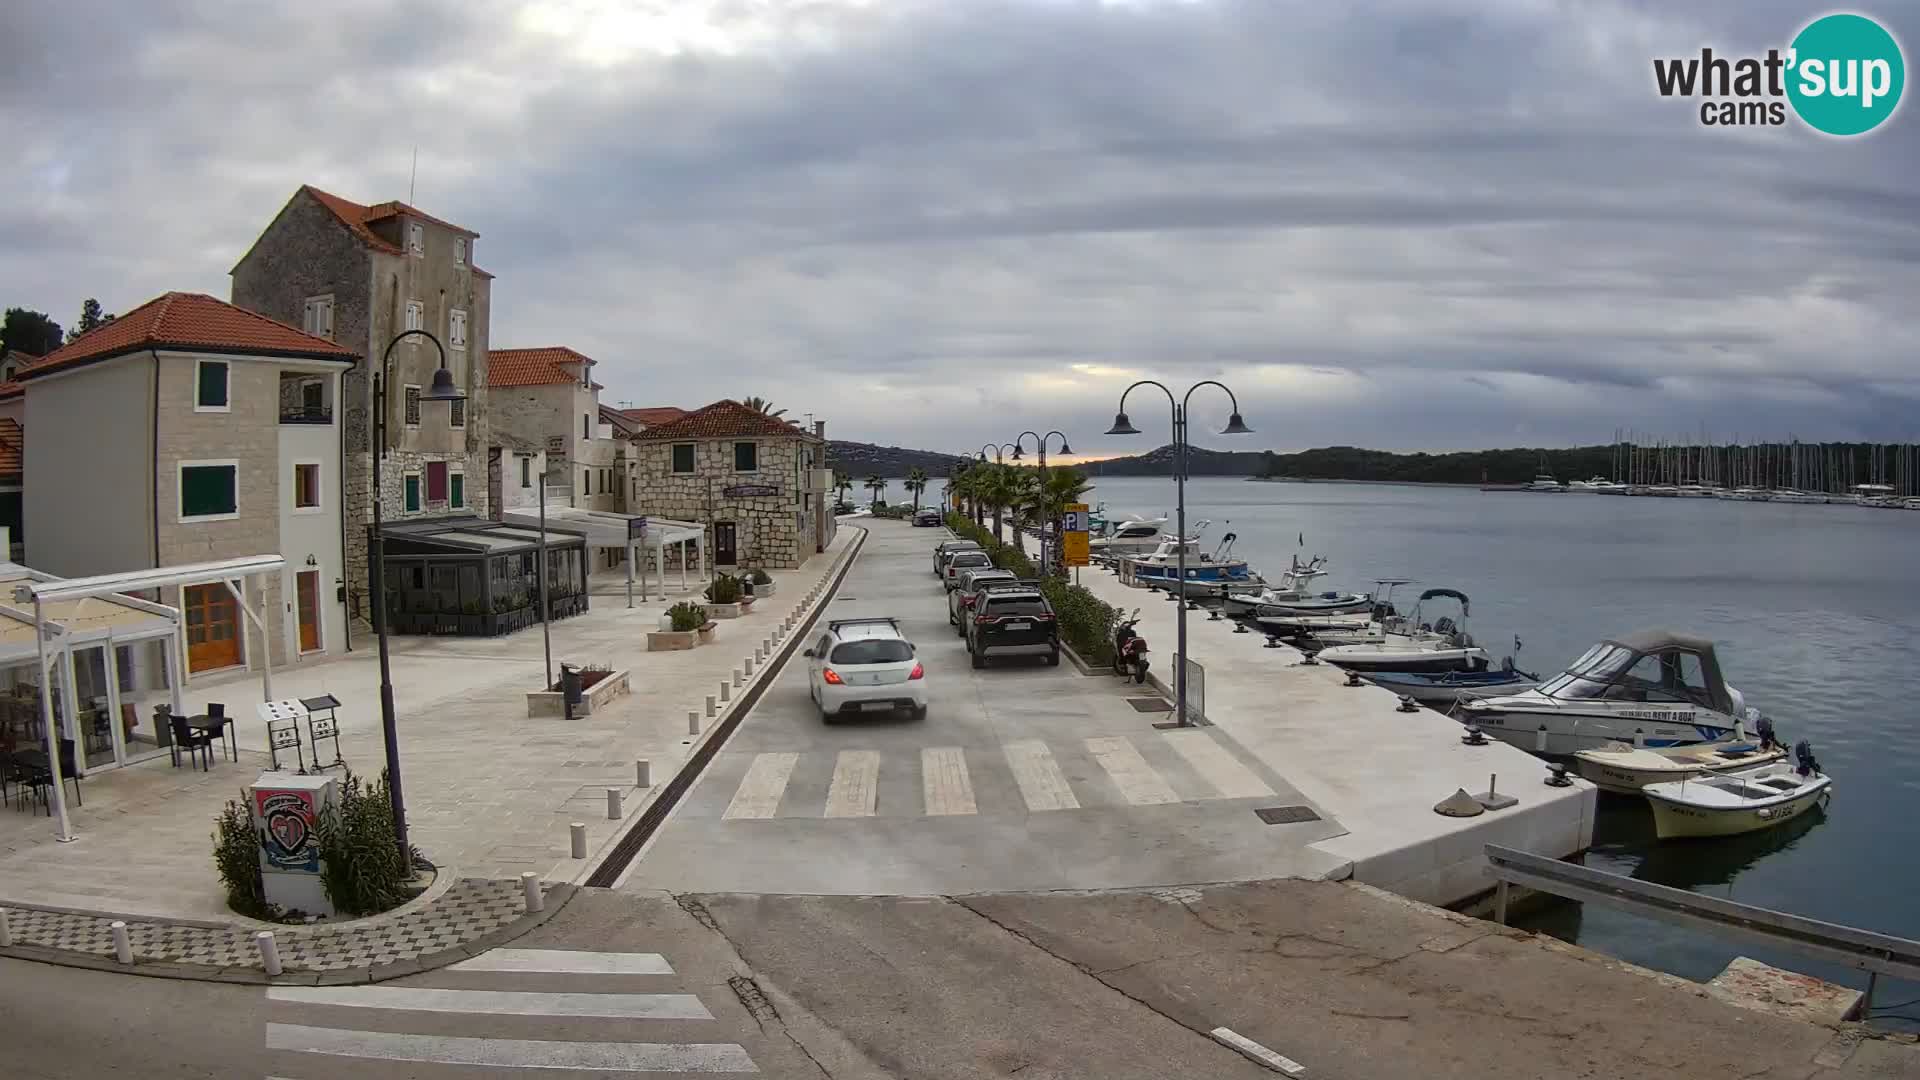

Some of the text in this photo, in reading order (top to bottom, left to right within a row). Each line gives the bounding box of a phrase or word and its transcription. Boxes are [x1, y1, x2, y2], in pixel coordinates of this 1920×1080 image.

[1066, 514, 1076, 529] P
[1652, 711, 1671, 721] RENT
[1671, 712, 1677, 721] A
[1678, 712, 1696, 722] BOAT
